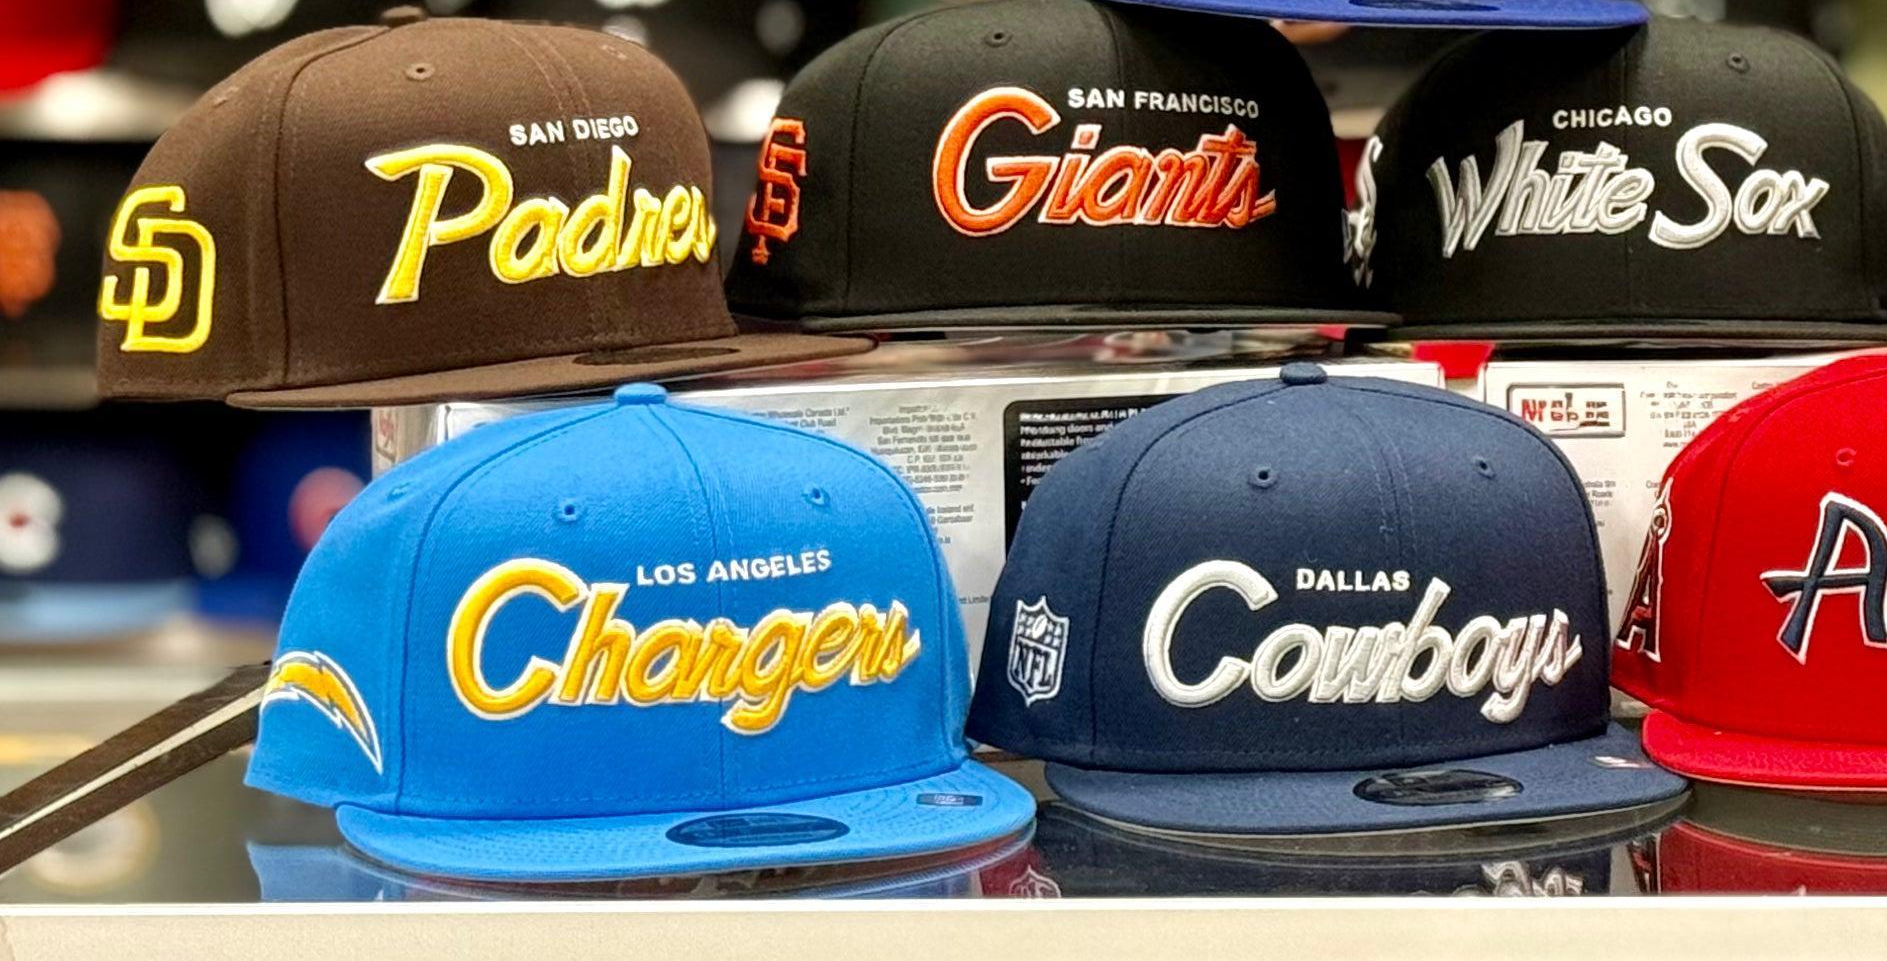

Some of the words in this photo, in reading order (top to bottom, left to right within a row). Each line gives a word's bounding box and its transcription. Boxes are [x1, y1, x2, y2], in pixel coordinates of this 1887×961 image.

[509, 118, 567, 146] SAN
[575, 114, 640, 143] DIEGO
[931, 85, 1278, 239] Giants
[1067, 86, 1129, 110] SAN
[1134, 88, 1260, 119] FRANCISCO
[1552, 105, 1674, 131] CHICAGO
[364, 143, 717, 305] Padres
[1426, 119, 1655, 260] White
[1648, 121, 1831, 251] Sox
[97, 185, 217, 352] SD
[635, 559, 696, 587] LOS
[705, 548, 832, 584] ANGELES
[1296, 567, 1411, 593] DALLAS
[446, 557, 923, 736] Chargers
[1142, 558, 1584, 724] Cowboys
